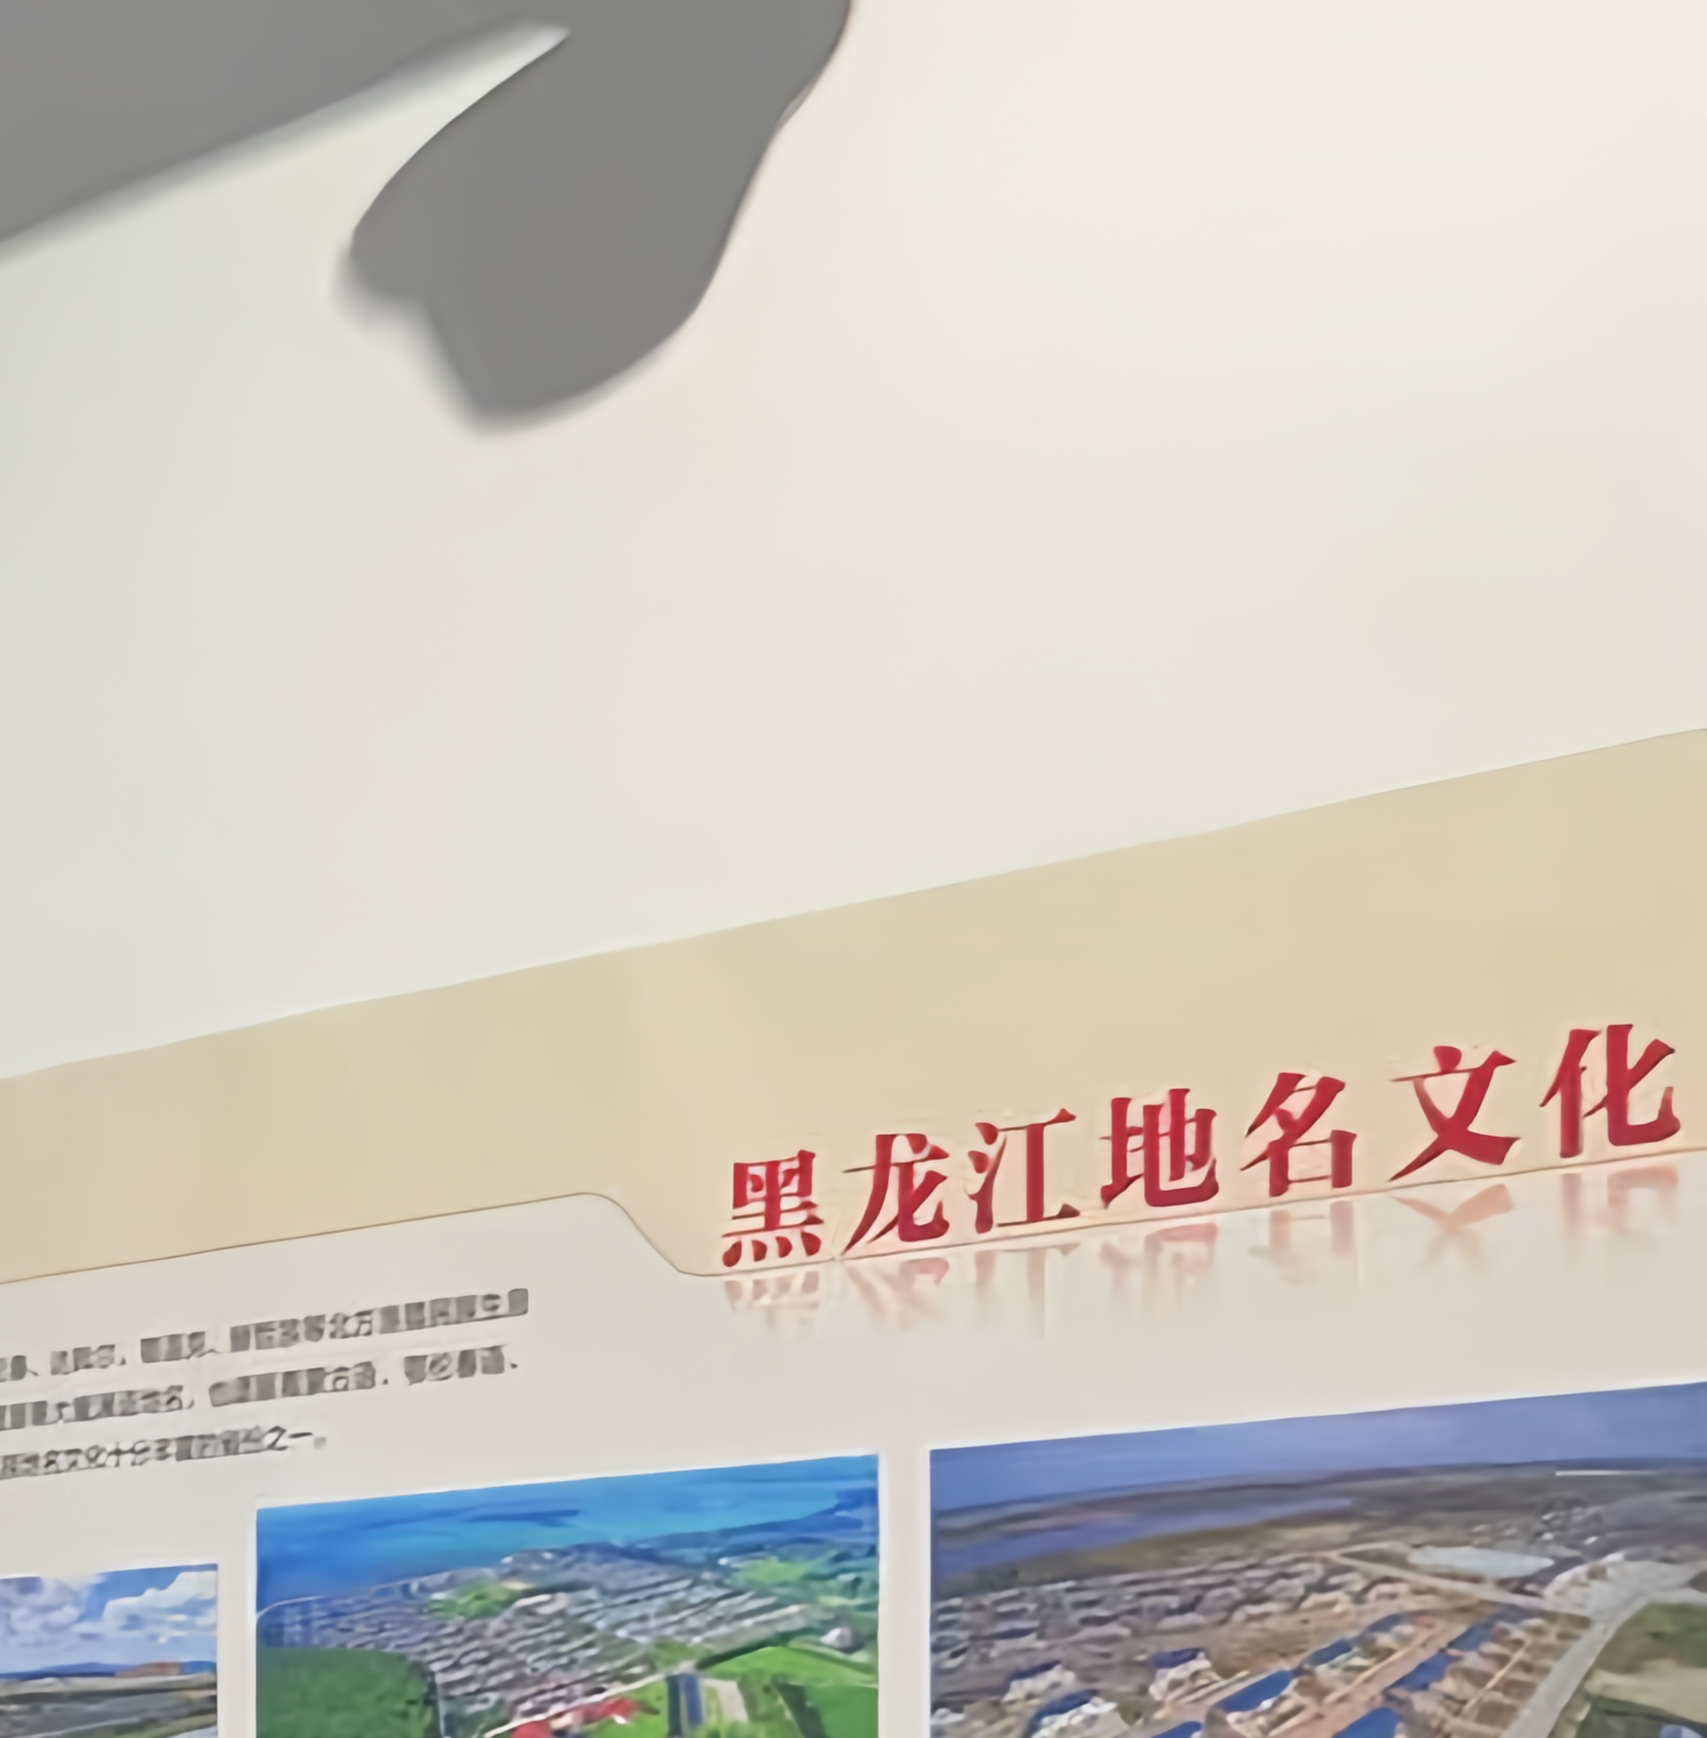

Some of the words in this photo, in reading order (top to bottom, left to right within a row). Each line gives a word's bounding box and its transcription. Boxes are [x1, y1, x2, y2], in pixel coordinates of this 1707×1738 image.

[720, 1023, 1683, 1268] 黑龙江地名文化
